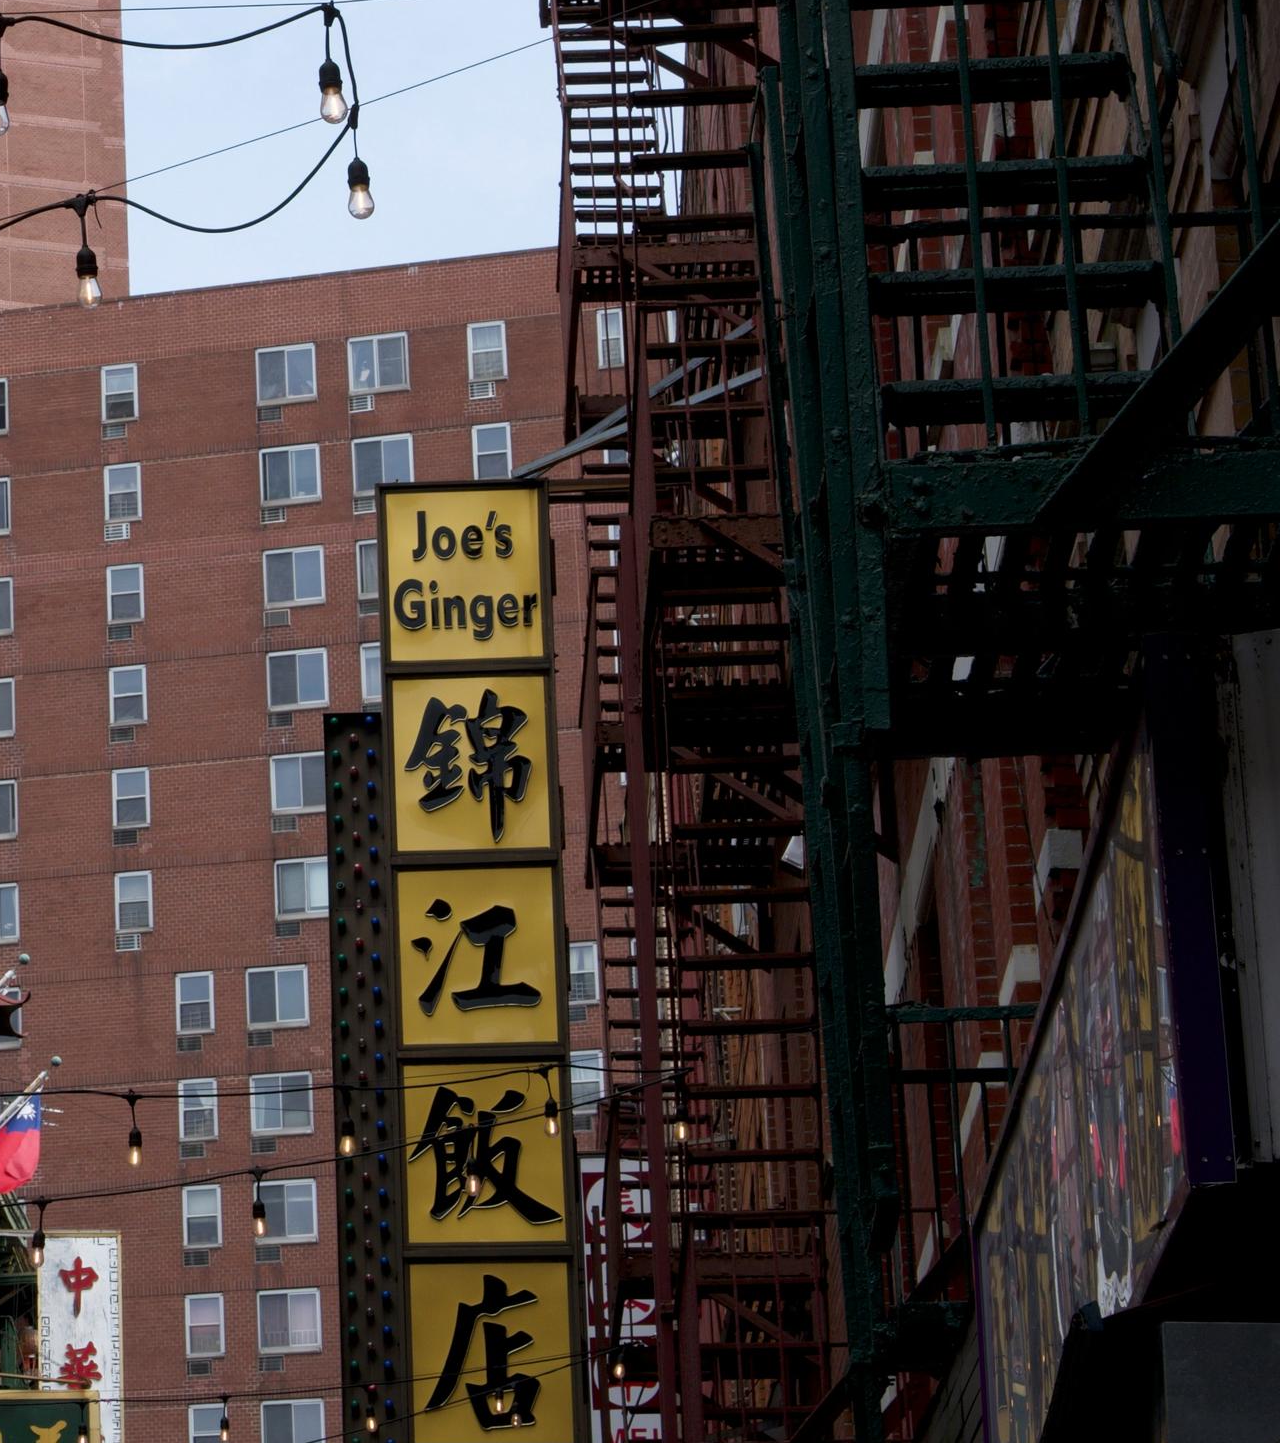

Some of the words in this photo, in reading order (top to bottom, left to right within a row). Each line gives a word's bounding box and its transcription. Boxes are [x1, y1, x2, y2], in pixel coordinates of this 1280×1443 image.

[413, 510, 514, 562] Joe's
[394, 578, 538, 641] Ginger
[404, 688, 562, 1433] 錦江飯店
